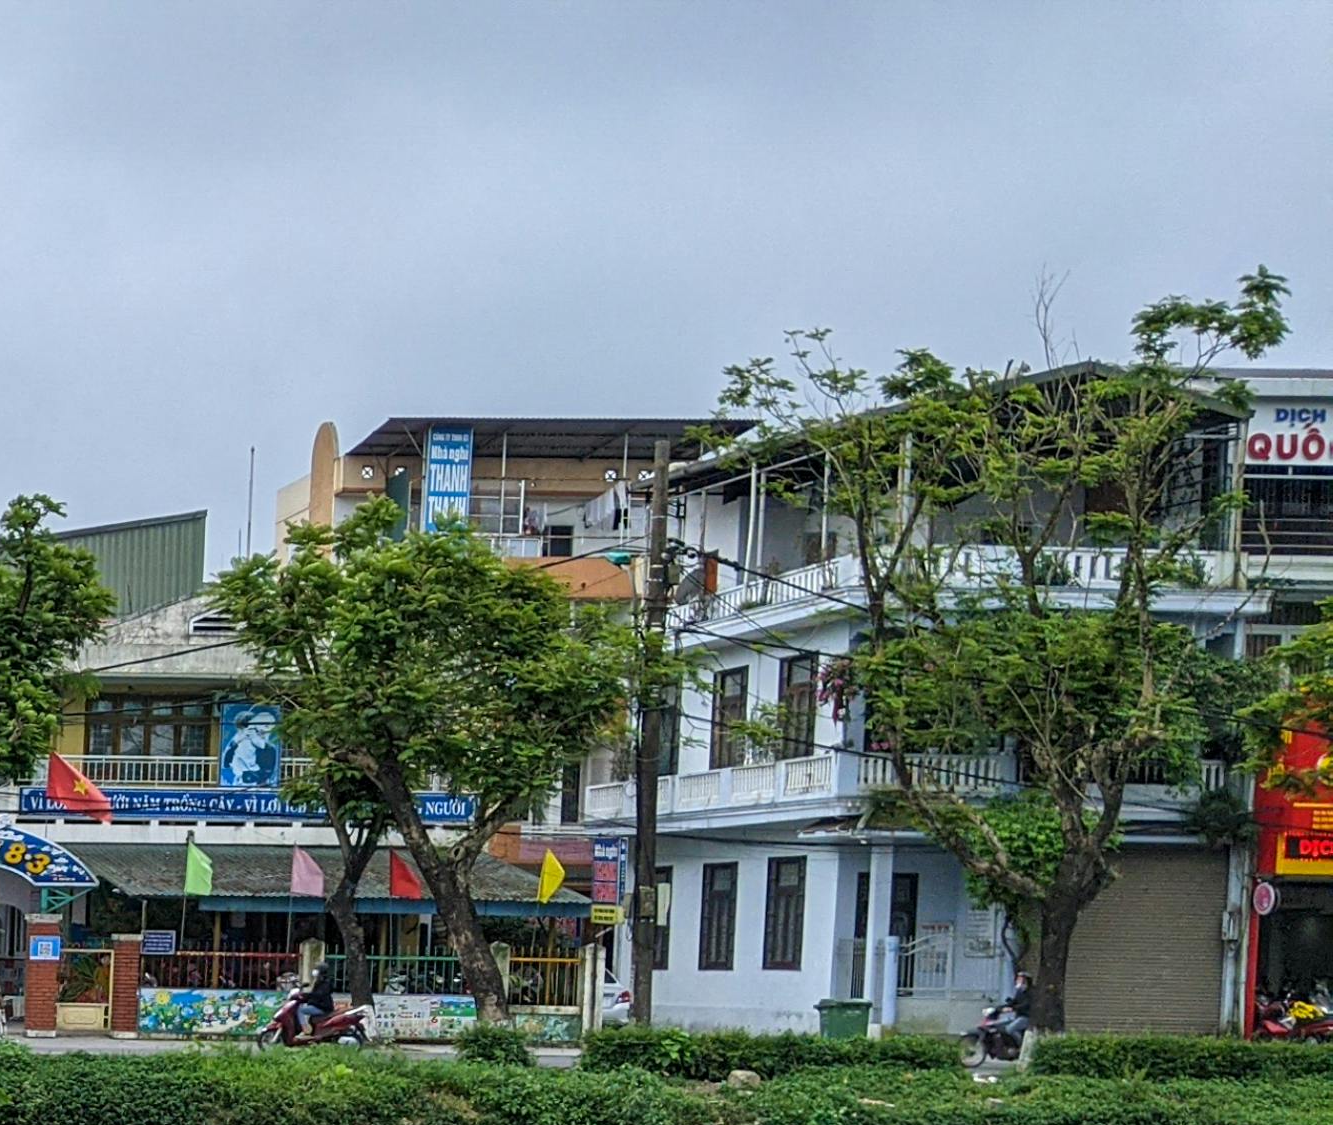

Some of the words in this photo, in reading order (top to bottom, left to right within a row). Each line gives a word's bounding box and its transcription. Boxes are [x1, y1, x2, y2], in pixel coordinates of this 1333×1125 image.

[1274, 408, 1327, 427] DỊCH
[1247, 422, 1333, 461] QUỐ
[430, 463, 468, 492] THANH
[209, 795, 233, 812] CÂY
[244, 794, 257, 813] VÌ
[425, 797, 465, 816] NGƯỜI
